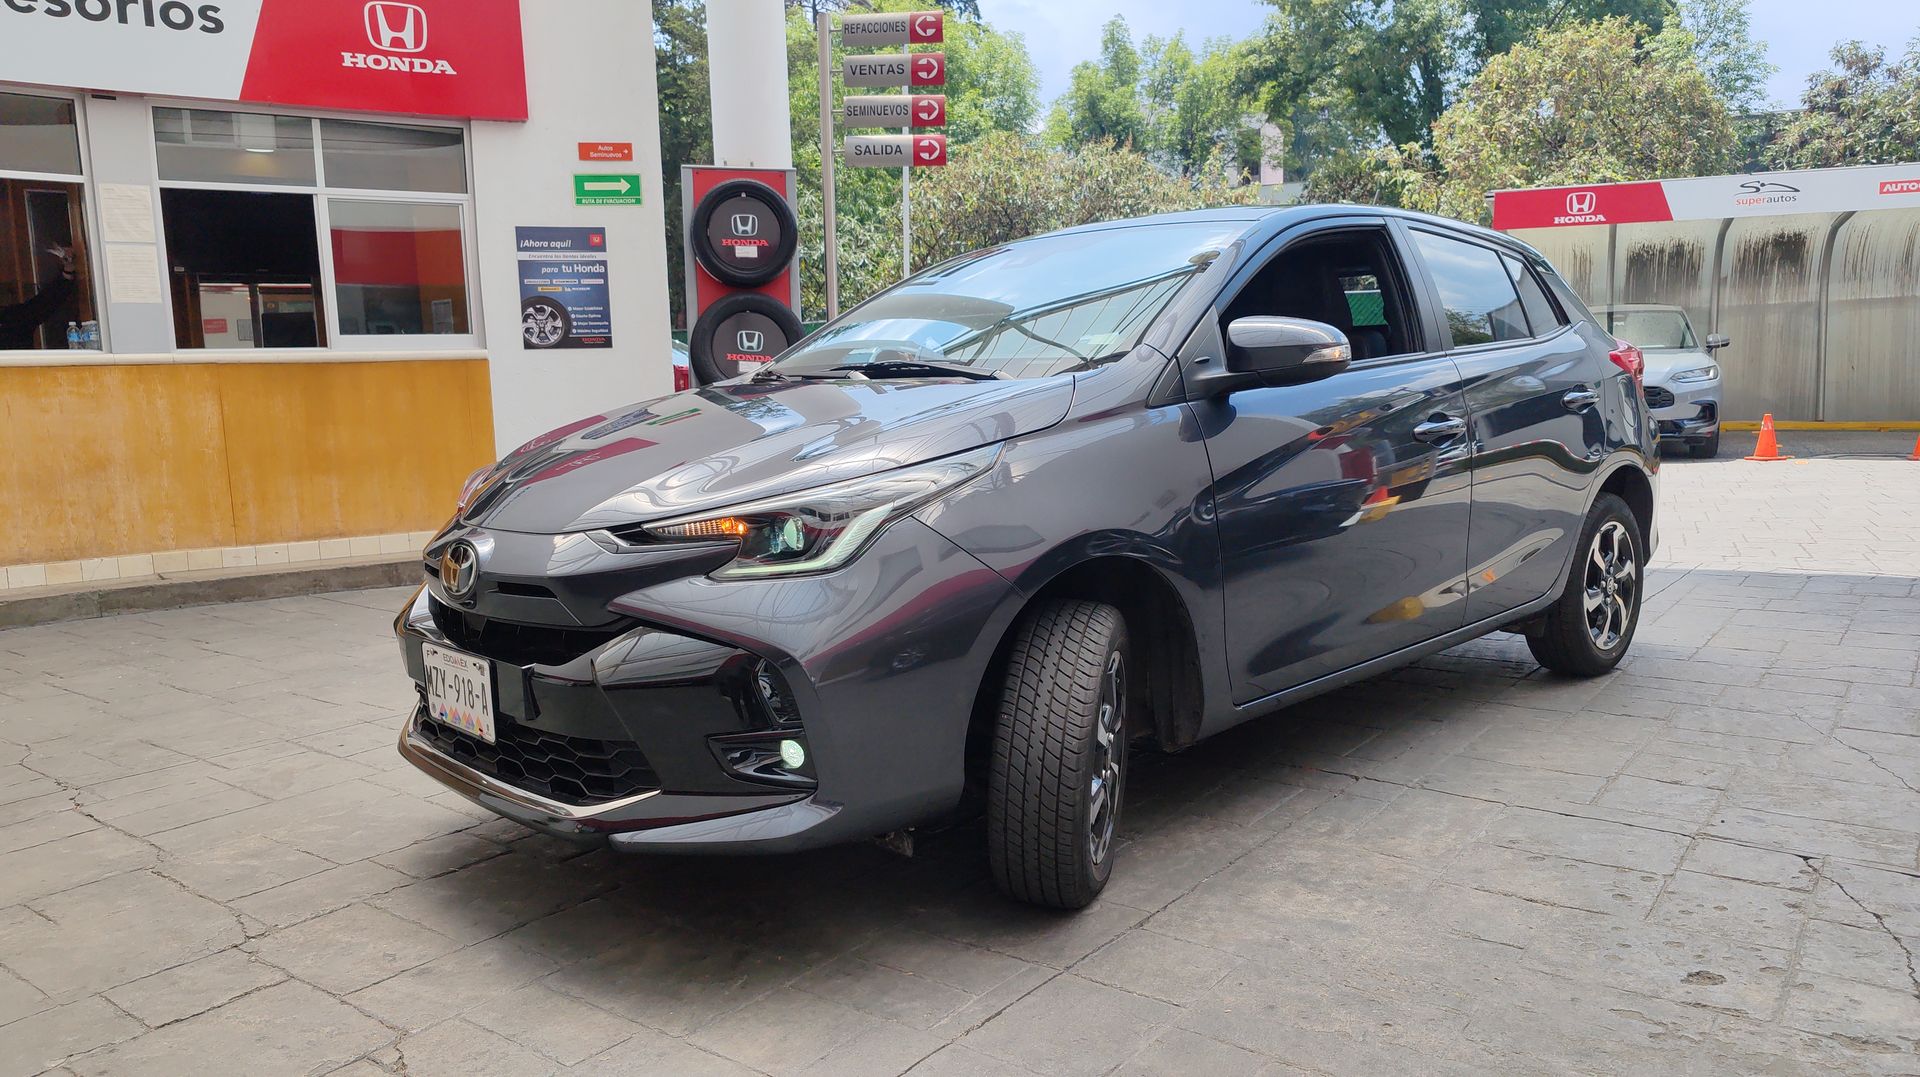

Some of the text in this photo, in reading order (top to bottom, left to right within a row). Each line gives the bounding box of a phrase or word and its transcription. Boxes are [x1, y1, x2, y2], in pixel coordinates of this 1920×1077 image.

[844, 21, 906, 35] REFACCIONES
[341, 51, 457, 75] HONDA
[850, 63, 905, 76] VENTAS
[846, 104, 909, 117] SEMINUEVOS
[854, 144, 903, 156] SALIDA
[1882, 182, 1920, 192] AUTO
[1735, 195, 1797, 206] superautos
[1553, 214, 1606, 224] HONDA
[520, 239, 548, 248] ¡Ahora
[721, 238, 768, 247] HONDA
[541, 263, 605, 274] para tu Honda
[726, 353, 772, 362] HONDA
[425, 664, 489, 717] MZY-918-A
